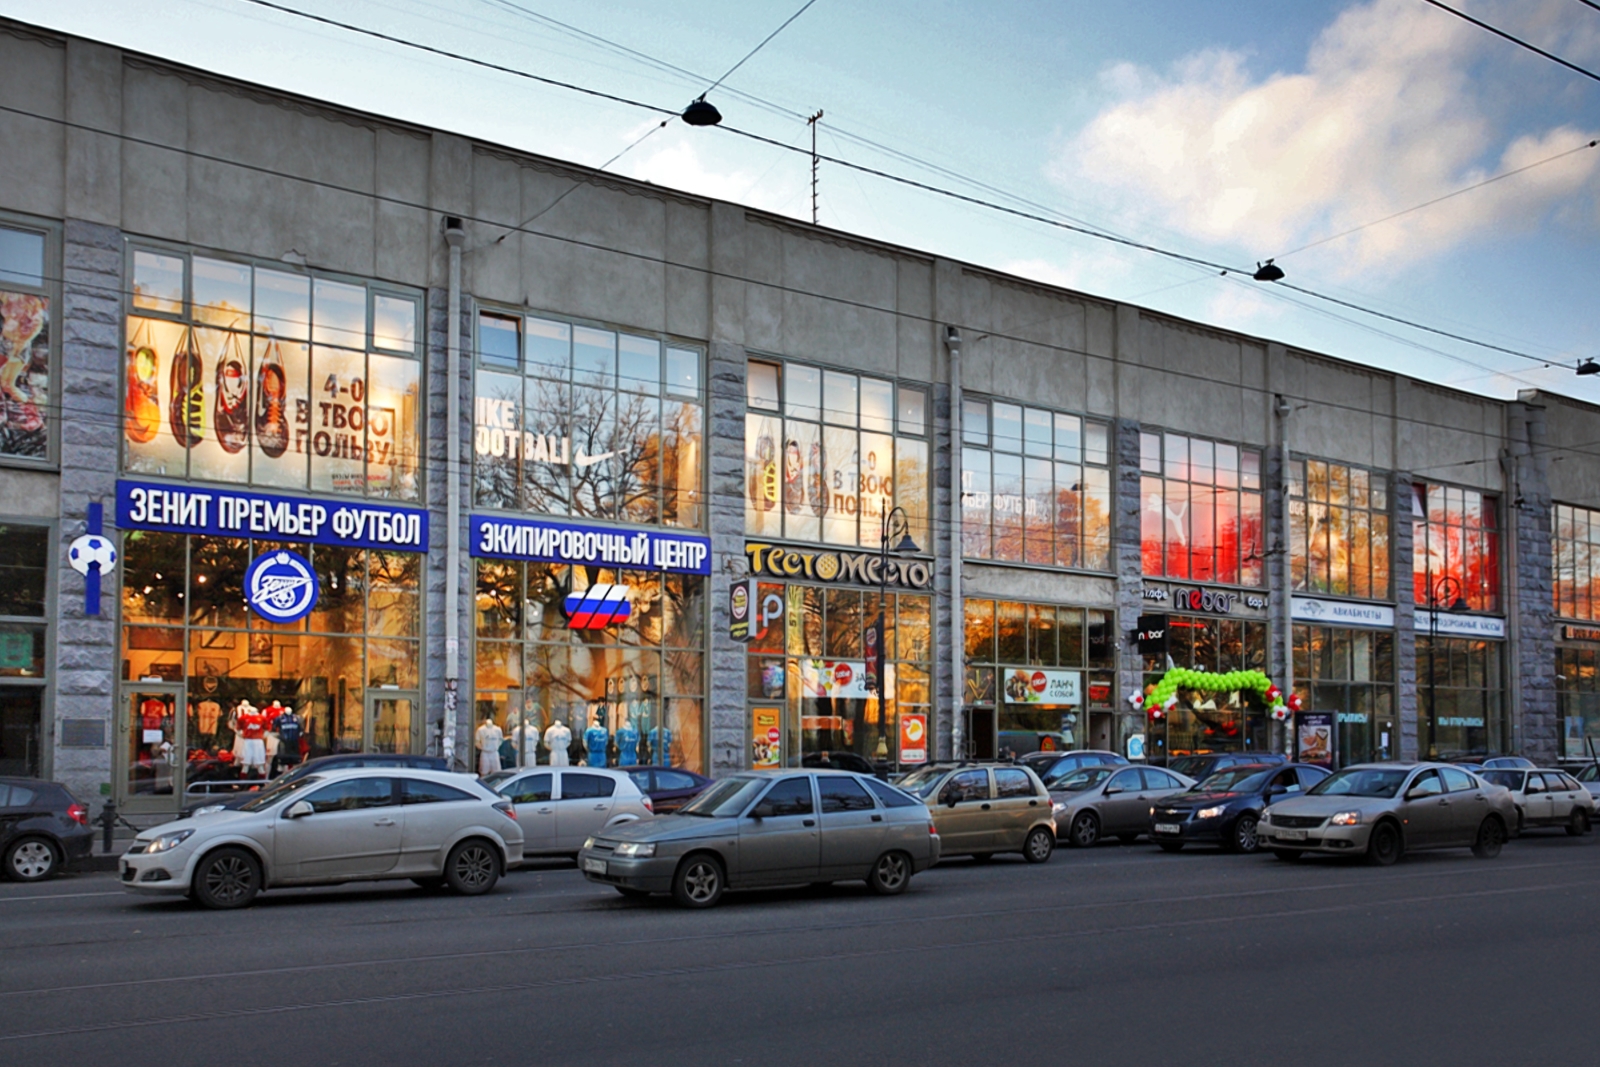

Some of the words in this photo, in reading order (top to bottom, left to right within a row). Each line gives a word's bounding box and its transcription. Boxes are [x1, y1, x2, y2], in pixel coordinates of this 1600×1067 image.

[296, 398, 309, 424] В
[320, 402, 388, 436] ТВОЮ
[833, 470, 843, 490] В
[848, 472, 893, 496] ТВОЮ
[129, 488, 212, 526] ЗЕНИТ
[218, 496, 327, 536] ПРЕМЬЕР
[332, 507, 421, 546] ФУТБОЛ
[480, 522, 650, 565] ЭКИПИРОВОЧНЫЙ
[653, 538, 707, 570] ЦЕНТР
[1175, 587, 1237, 613] nebar
